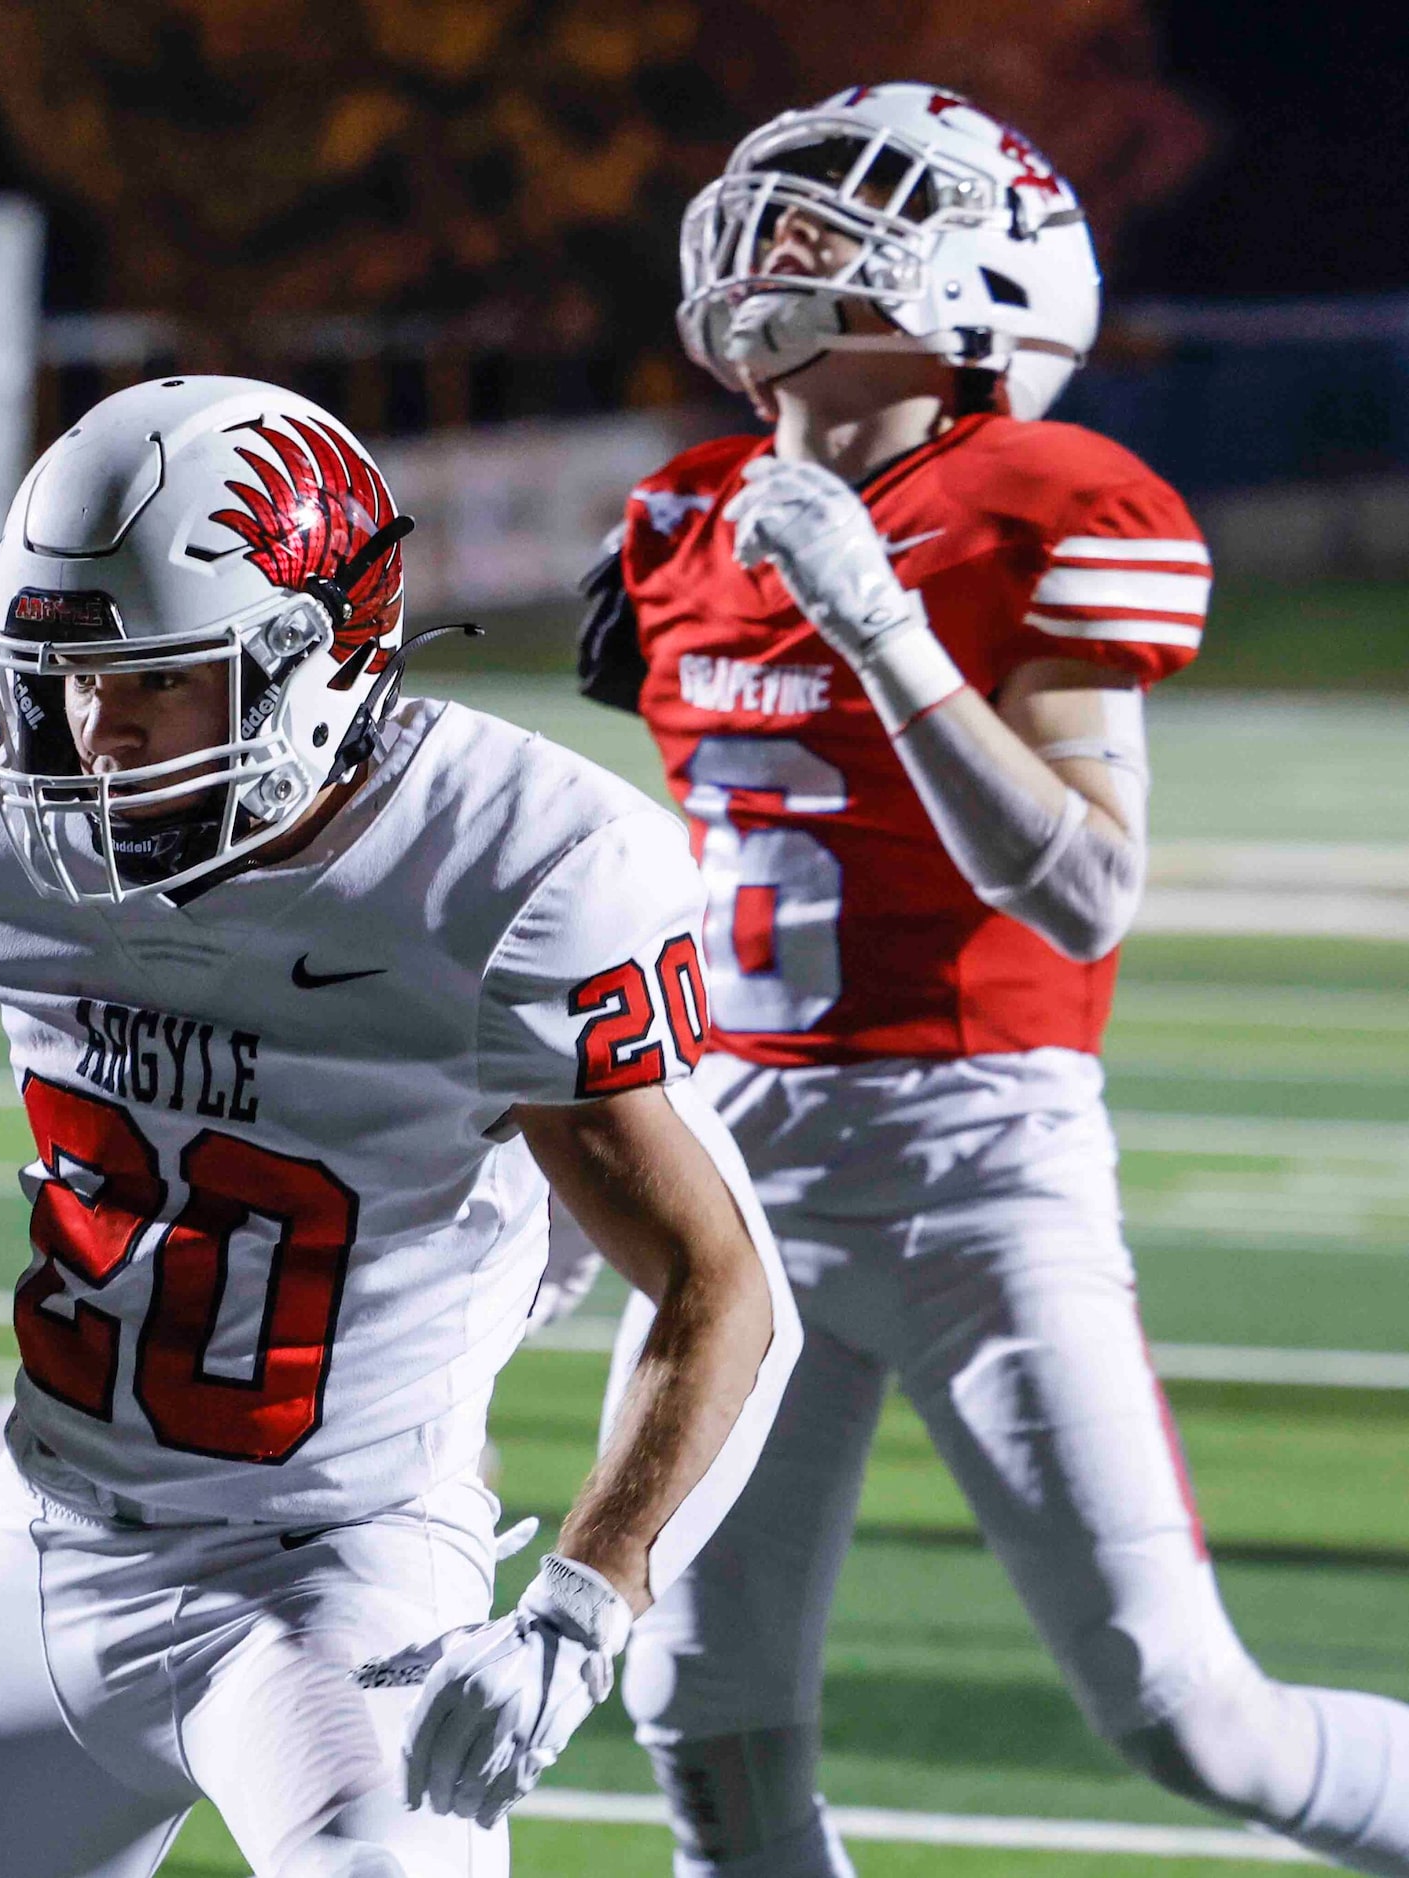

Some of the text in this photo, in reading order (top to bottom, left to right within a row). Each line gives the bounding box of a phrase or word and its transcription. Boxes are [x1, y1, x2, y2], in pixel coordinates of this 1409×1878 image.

[241, 682, 282, 739] ddell
[111, 838, 152, 853] iddell
[683, 733, 849, 1033] 6
[76, 998, 260, 1124] ARGYLE
[568, 931, 708, 1099] 20
[13, 1066, 360, 1467] 20
